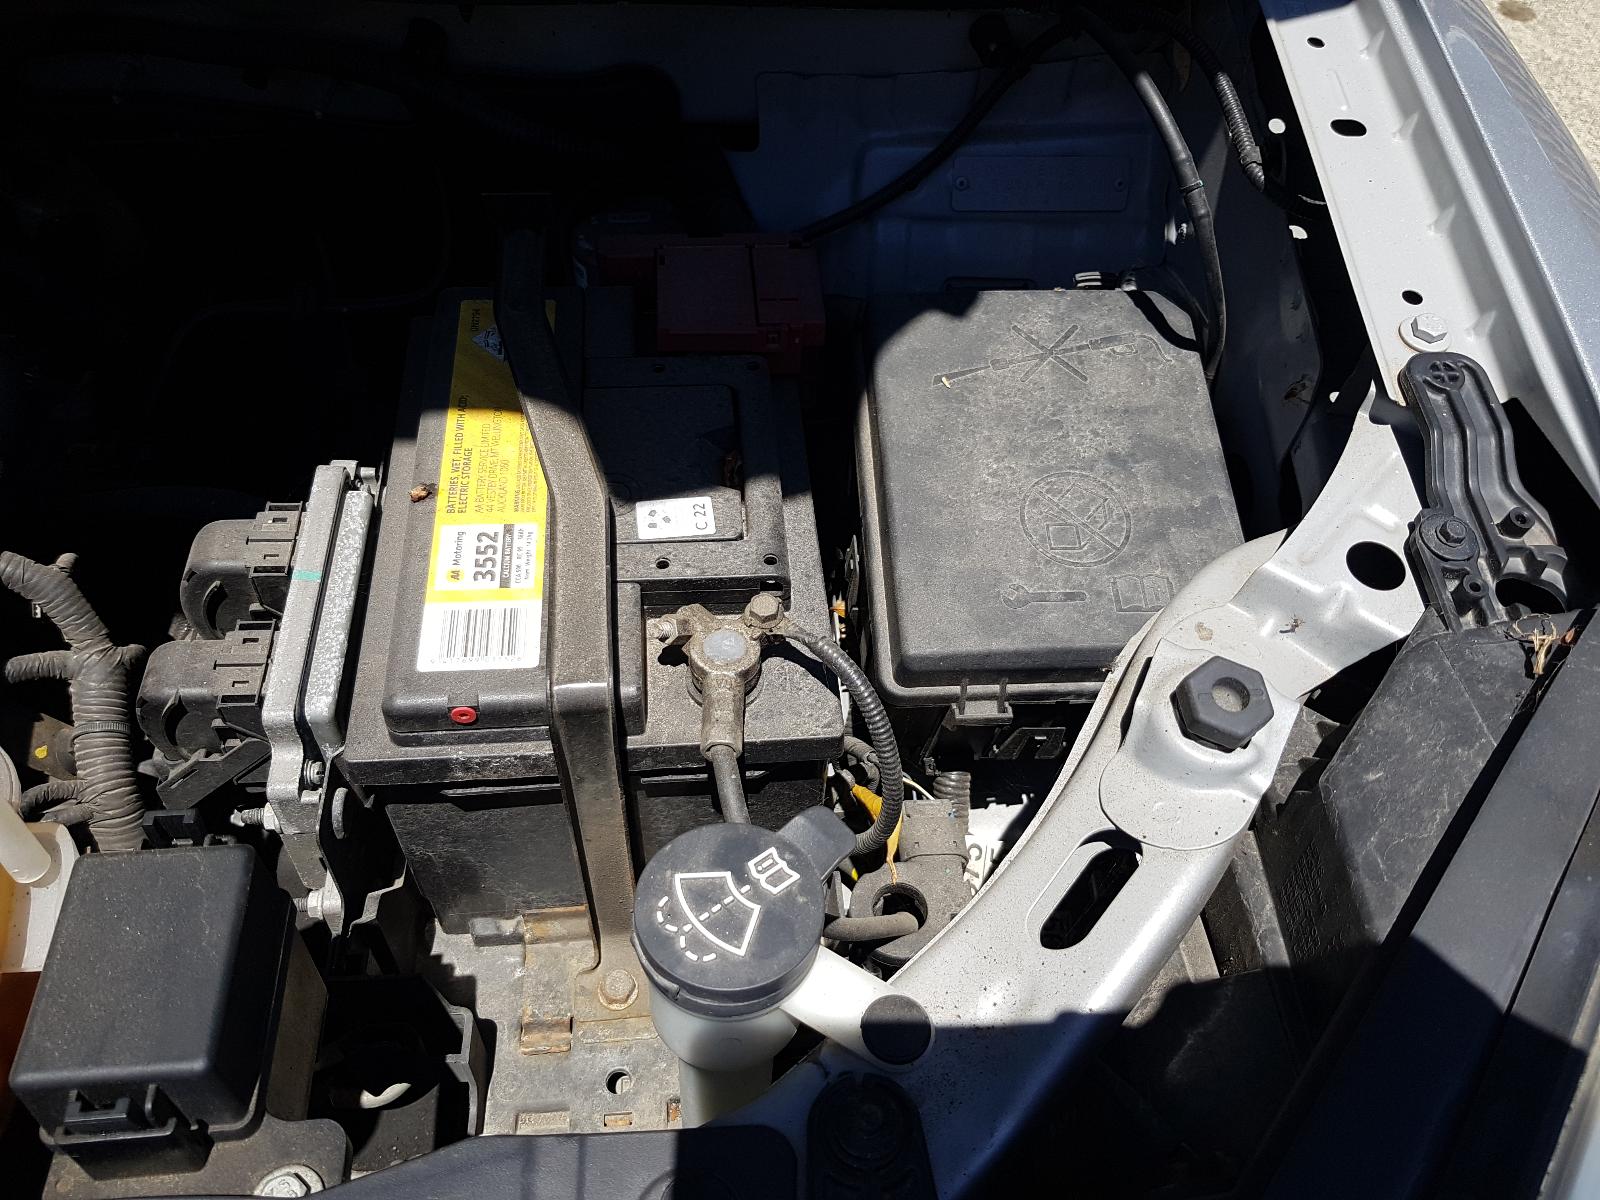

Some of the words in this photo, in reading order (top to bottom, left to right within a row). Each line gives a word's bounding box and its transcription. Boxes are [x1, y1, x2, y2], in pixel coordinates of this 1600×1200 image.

[455, 413, 466, 431] WITH
[453, 433, 463, 455] FILLED
[480, 424, 490, 447] LIMITED
[450, 456, 462, 473] WET,
[462, 447, 473, 480] STORAGE
[478, 449, 489, 474] SERVICE
[446, 474, 459, 513] BATTERIES,
[458, 481, 469, 514] ELECTRIC
[475, 475, 486, 503] BATTERY
[497, 476, 508, 513] AUCKLAND
[692, 503, 707, 517] 22
[695, 521, 708, 530] C
[451, 531, 466, 566] Motoring
[473, 531, 499, 582] 3552
[504, 533, 513, 556] BATTERY
[503, 555, 512, 578] CALCIUM
